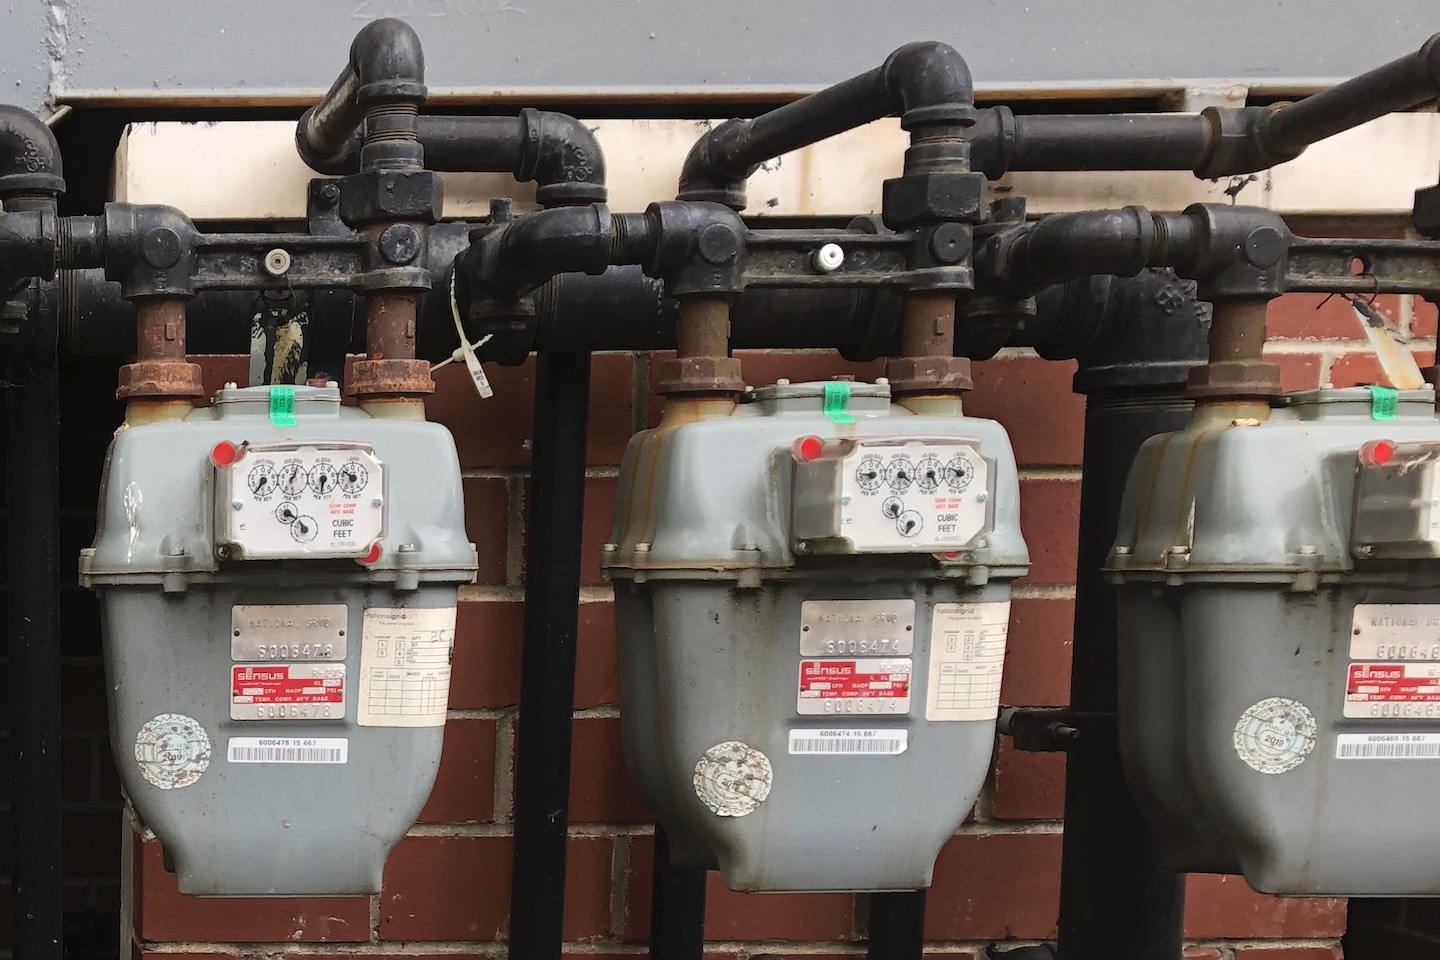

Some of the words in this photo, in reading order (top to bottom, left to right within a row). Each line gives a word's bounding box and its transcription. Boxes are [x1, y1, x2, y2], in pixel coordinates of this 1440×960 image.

[937, 514, 959, 522] CUBIC
[332, 519, 353, 527] CUBIC
[938, 524, 956, 532] FEET
[1377, 646, 1440, 659] 600646
[806, 667, 851, 675] SENSUS
[1354, 671, 1400, 679] SENSUS
[237, 672, 284, 680] SENSUS
[1265, 735, 1284, 746] 2019
